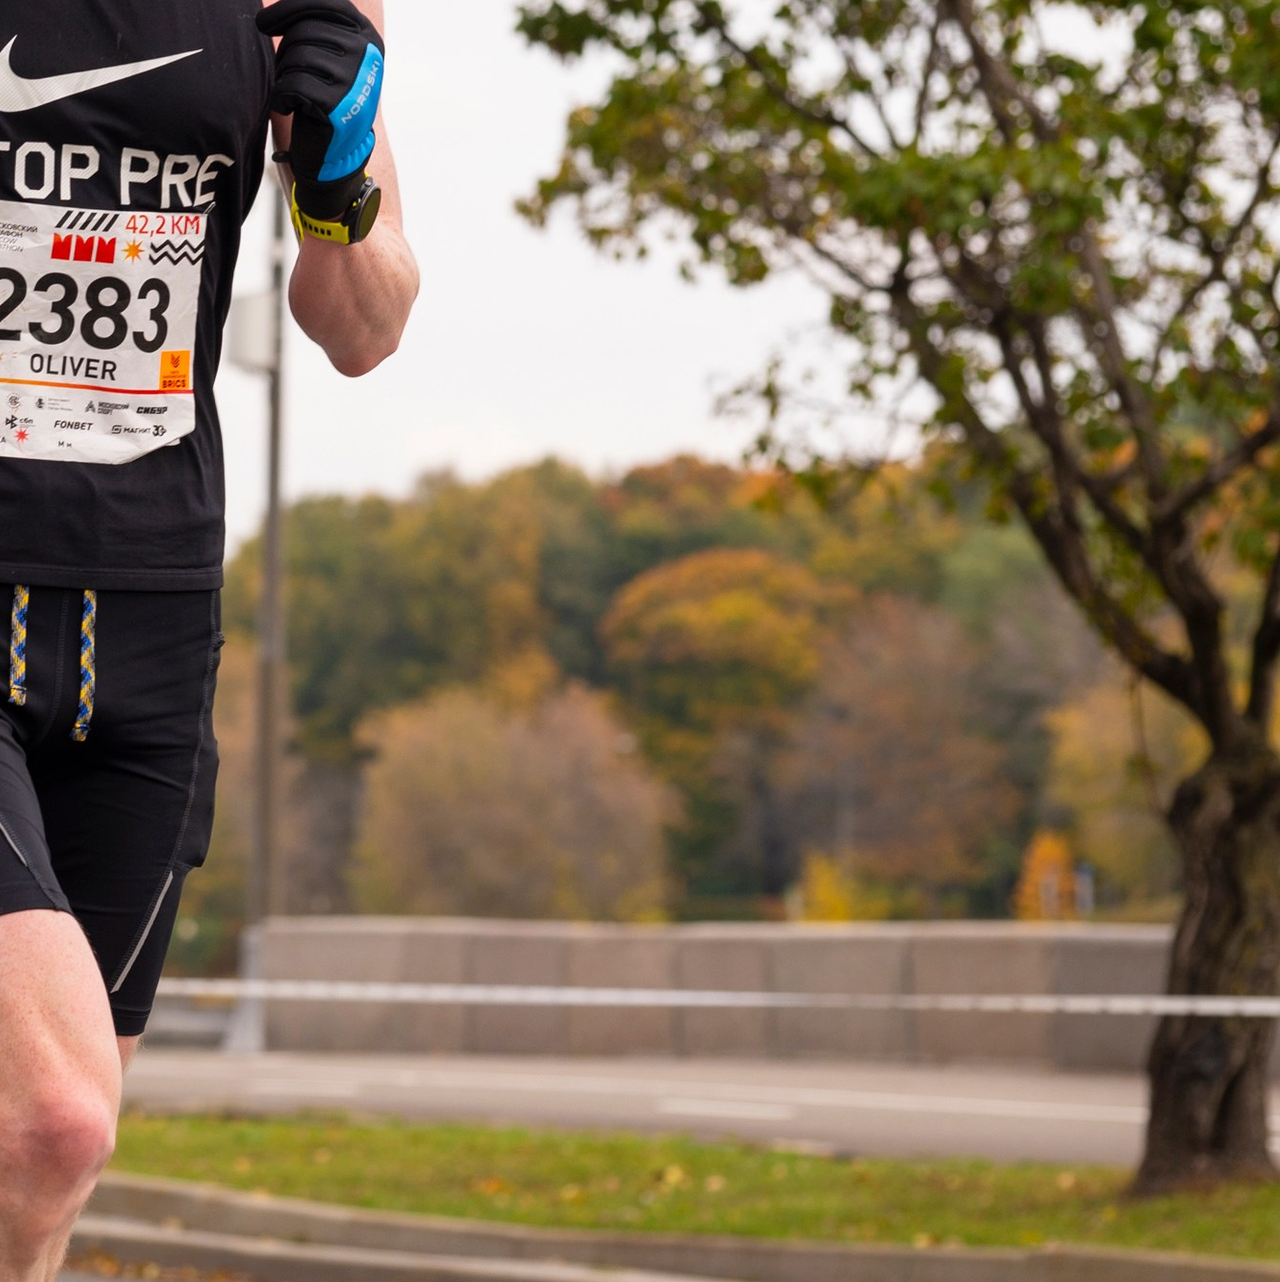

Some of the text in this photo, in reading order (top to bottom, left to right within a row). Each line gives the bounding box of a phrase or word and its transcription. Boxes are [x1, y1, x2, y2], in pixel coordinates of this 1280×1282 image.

[340, 60, 380, 124] NORDSKI
[125, 215, 200, 237] 42,2 KM
[30, 353, 117, 381] OLIVER
[163, 379, 186, 388] BRICS
[136, 406, 168, 414] СИБУР
[53, 420, 94, 431] FONBET
